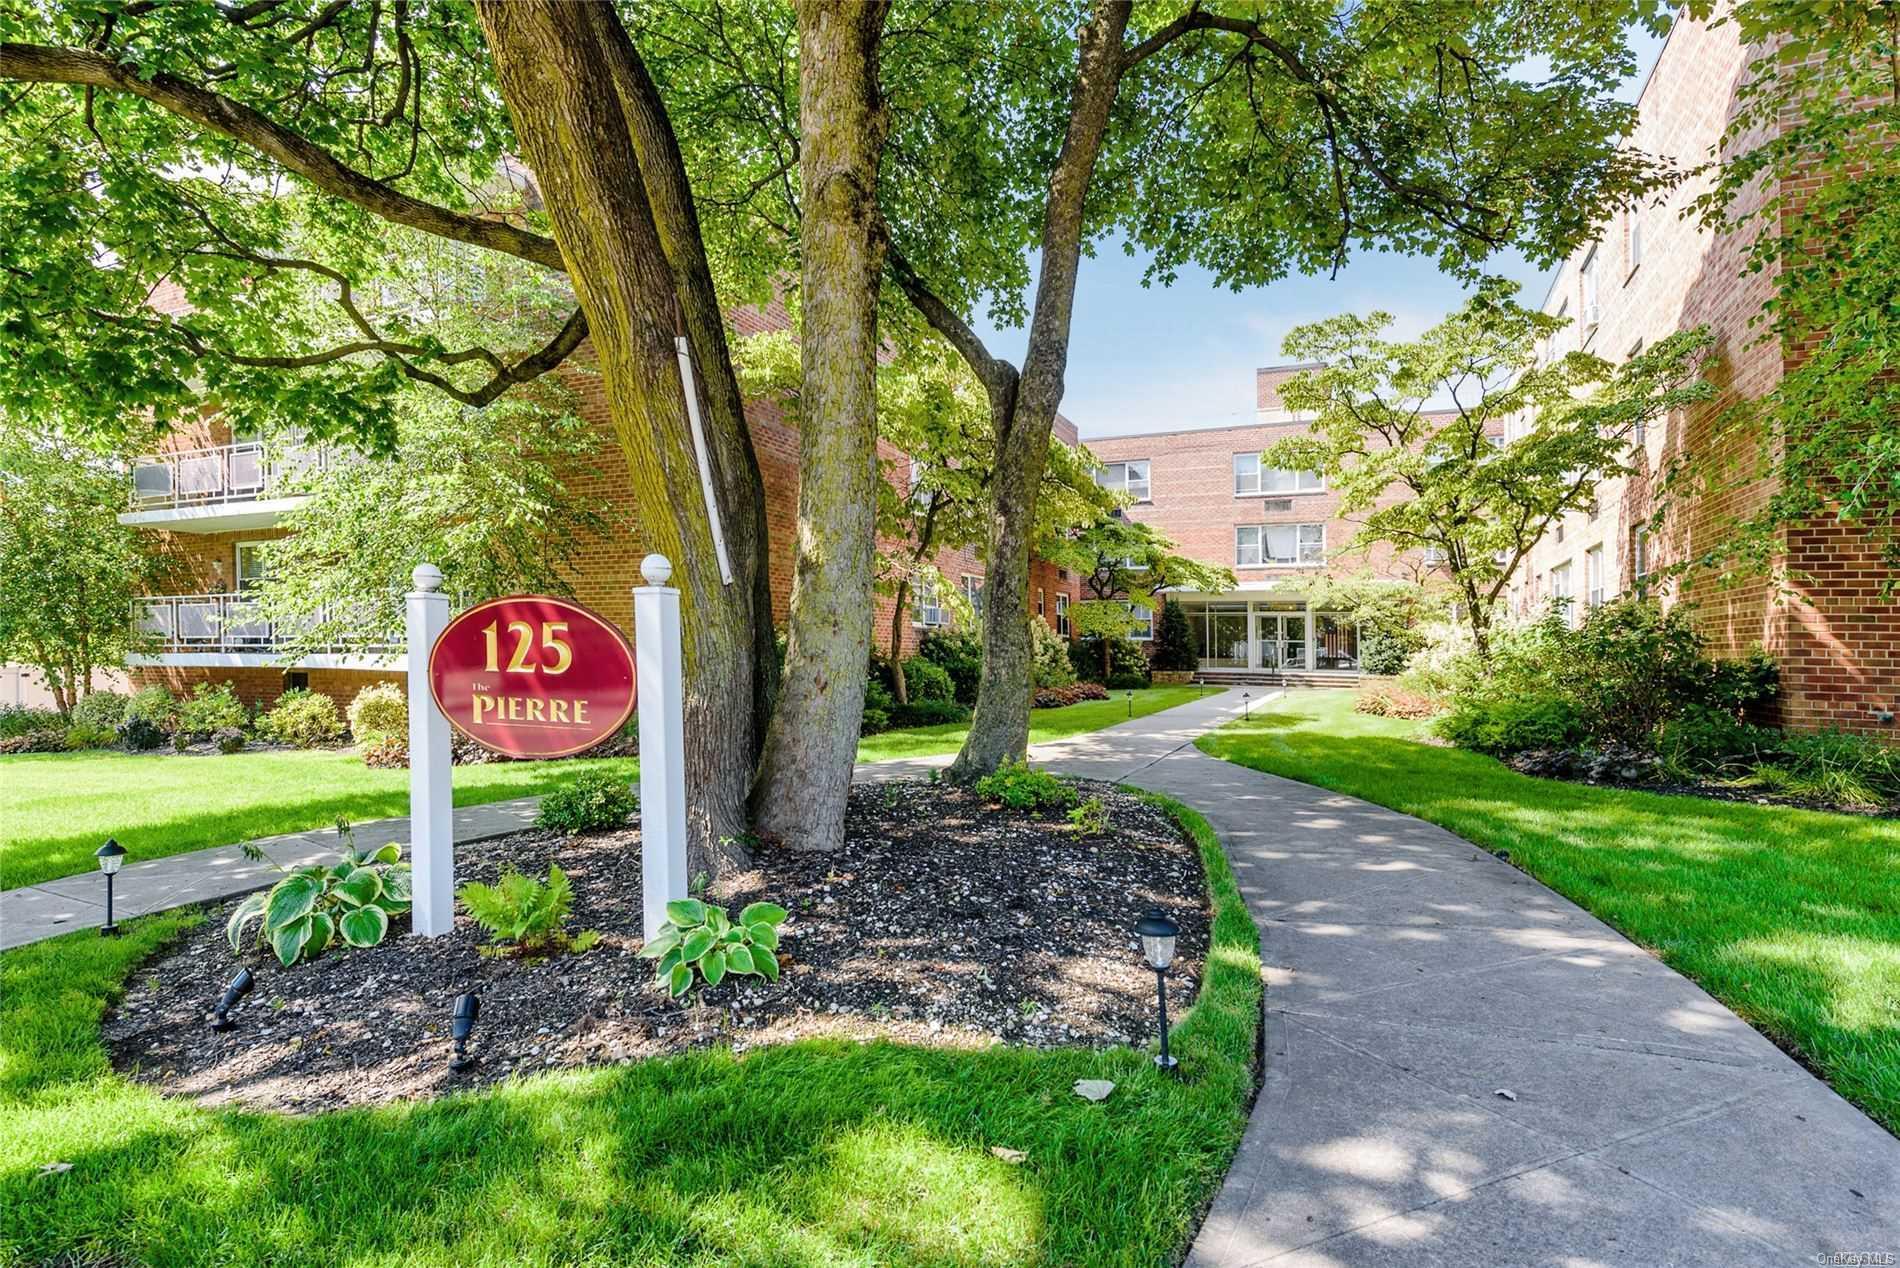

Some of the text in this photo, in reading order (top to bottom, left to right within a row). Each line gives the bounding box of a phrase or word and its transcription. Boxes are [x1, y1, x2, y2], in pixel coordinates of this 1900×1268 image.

[481, 619, 573, 675] 125
[472, 682, 491, 692] The
[472, 694, 592, 725] PIERRE
